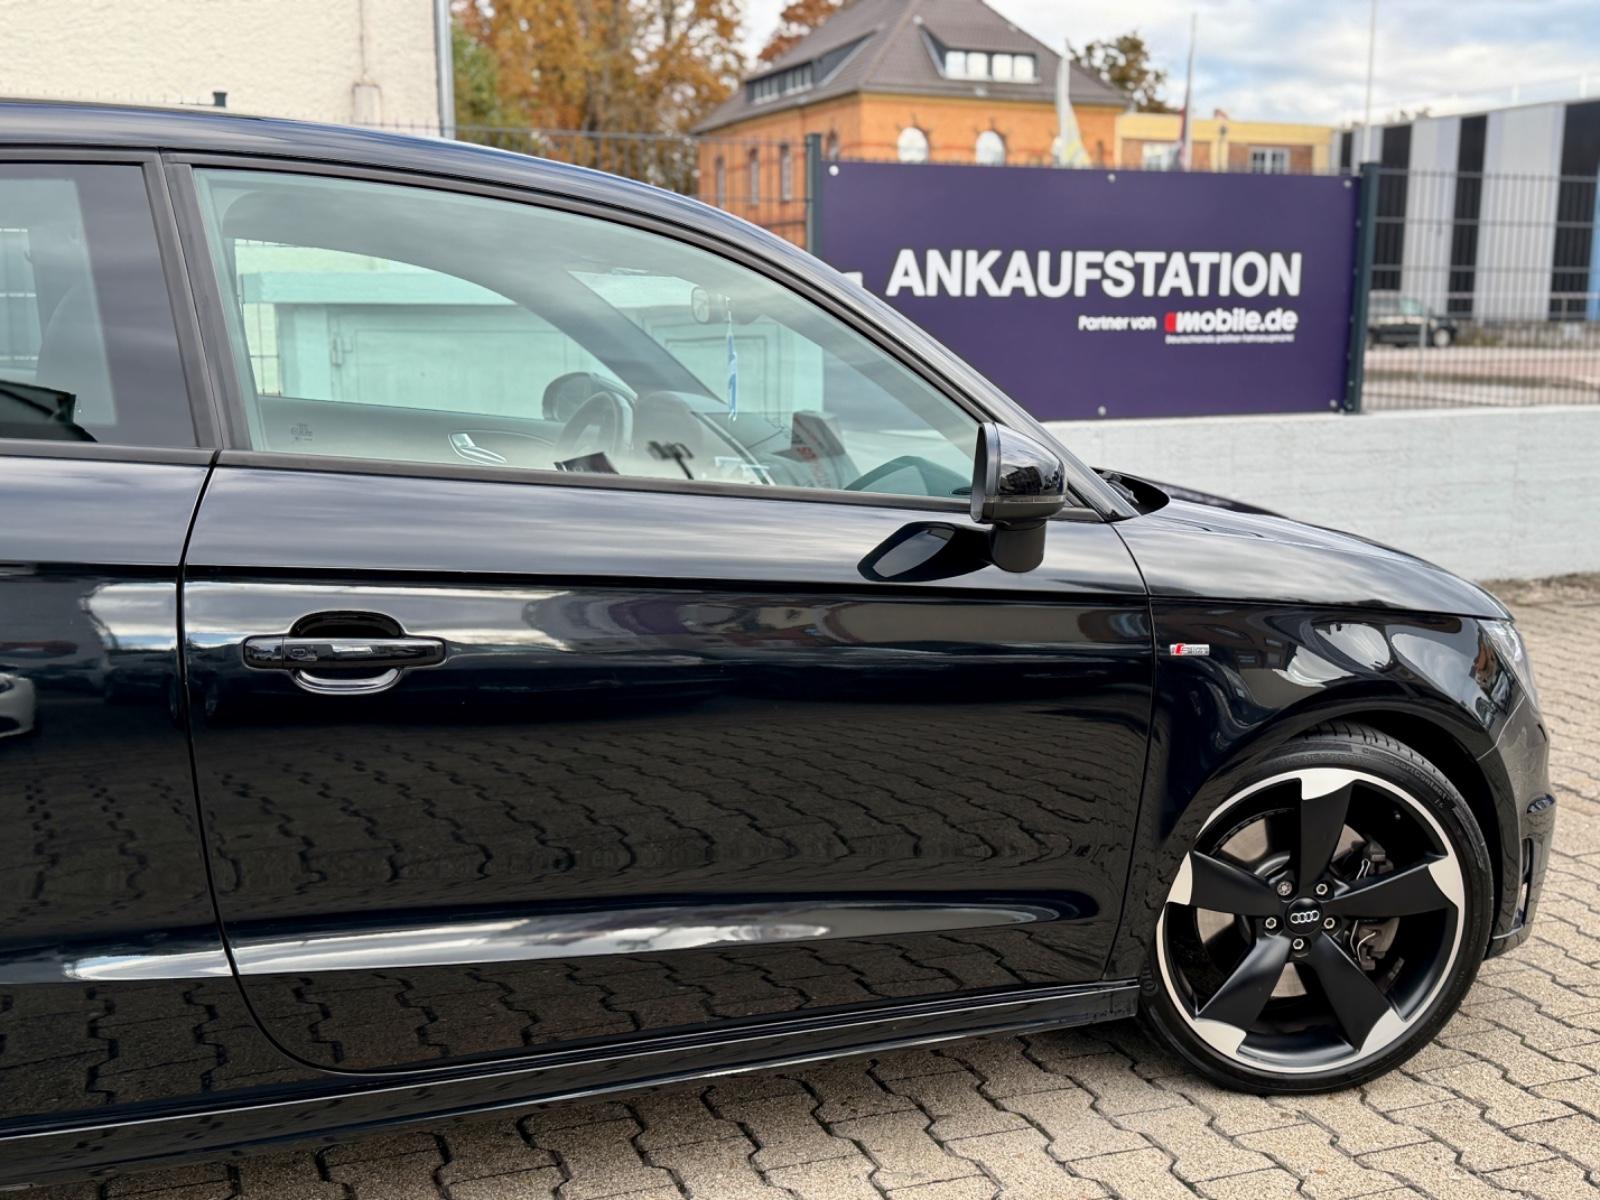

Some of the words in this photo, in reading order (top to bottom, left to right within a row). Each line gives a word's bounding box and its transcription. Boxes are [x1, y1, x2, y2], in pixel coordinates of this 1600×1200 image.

[886, 249, 1302, 297] ANKAUFSTATION
[1078, 314, 1128, 331] Partner
[1130, 315, 1157, 331] von
[1176, 307, 1298, 333] mobile.de
